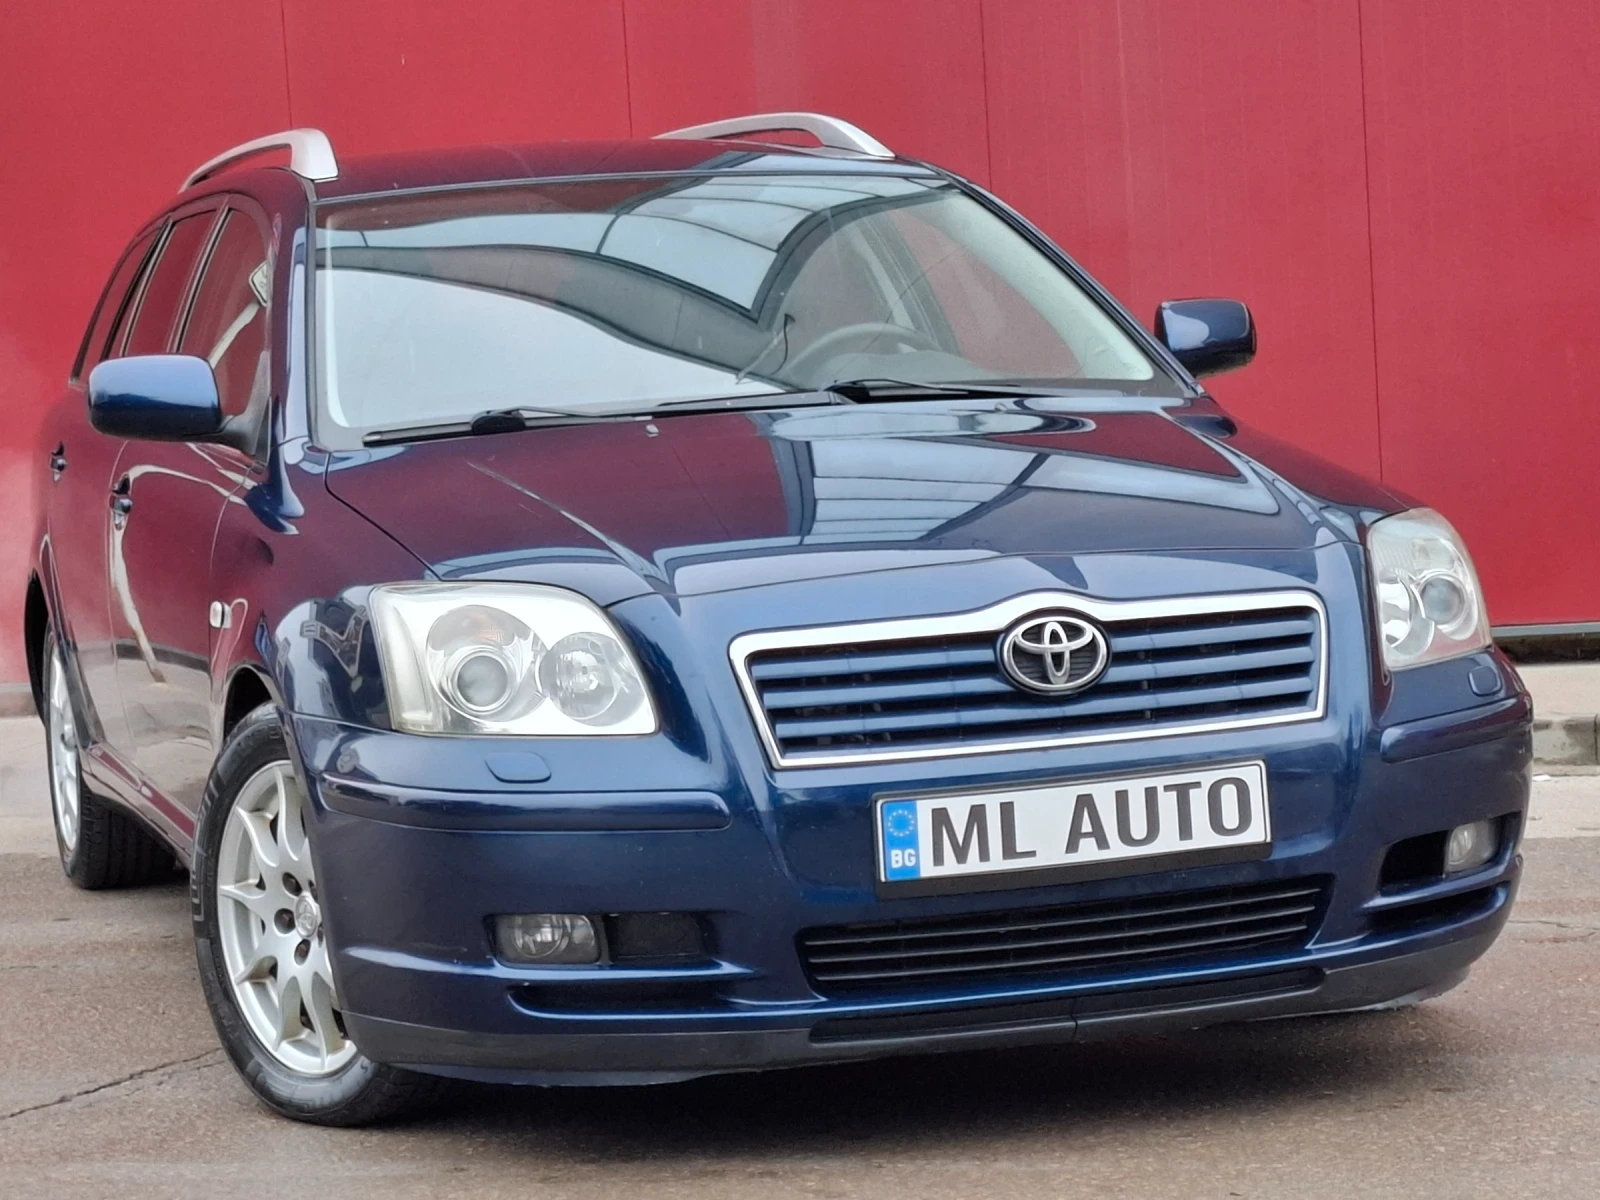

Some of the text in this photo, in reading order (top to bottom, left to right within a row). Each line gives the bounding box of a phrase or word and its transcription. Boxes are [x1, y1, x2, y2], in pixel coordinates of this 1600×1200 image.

[931, 777, 1253, 867] ML AUTO
[891, 849, 917, 868] BG
